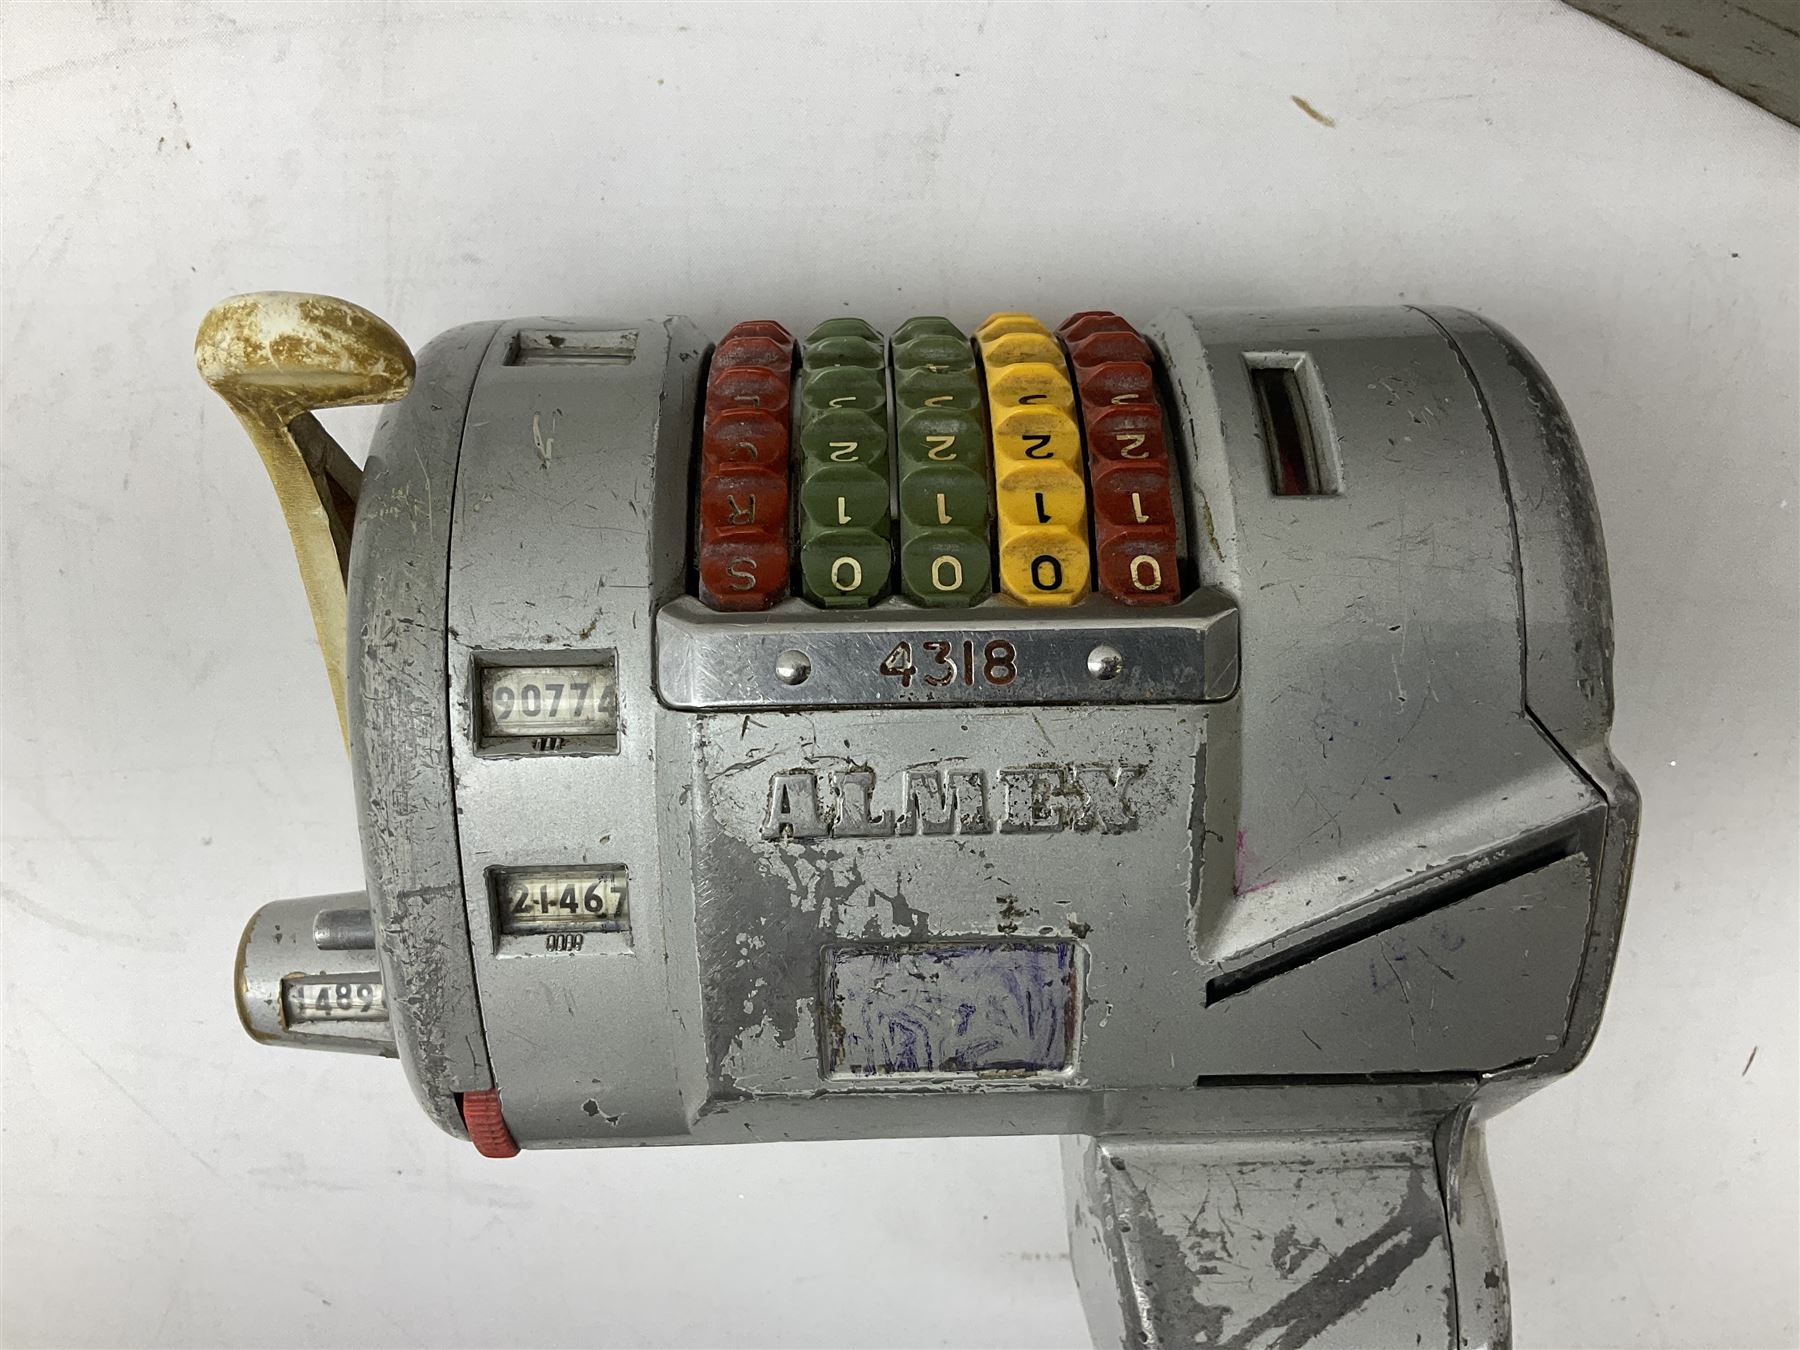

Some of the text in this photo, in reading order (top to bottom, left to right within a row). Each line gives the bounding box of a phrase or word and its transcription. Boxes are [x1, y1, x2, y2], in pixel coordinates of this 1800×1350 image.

[829, 441, 859, 462] 2
[925, 435, 958, 462] 2
[1022, 434, 1055, 460] 2
[1116, 433, 1150, 460] 2
[727, 494, 757, 526] R
[837, 496, 852, 525] 1
[936, 493, 953, 525] 1
[1035, 492, 1052, 523] 1
[1131, 492, 1150, 524] 1
[727, 556, 757, 592] S
[831, 556, 863, 592] 0
[931, 555, 964, 592] 0
[1031, 554, 1063, 591] 0
[1129, 554, 1162, 592] 0
[879, 639, 1018, 688] 4318
